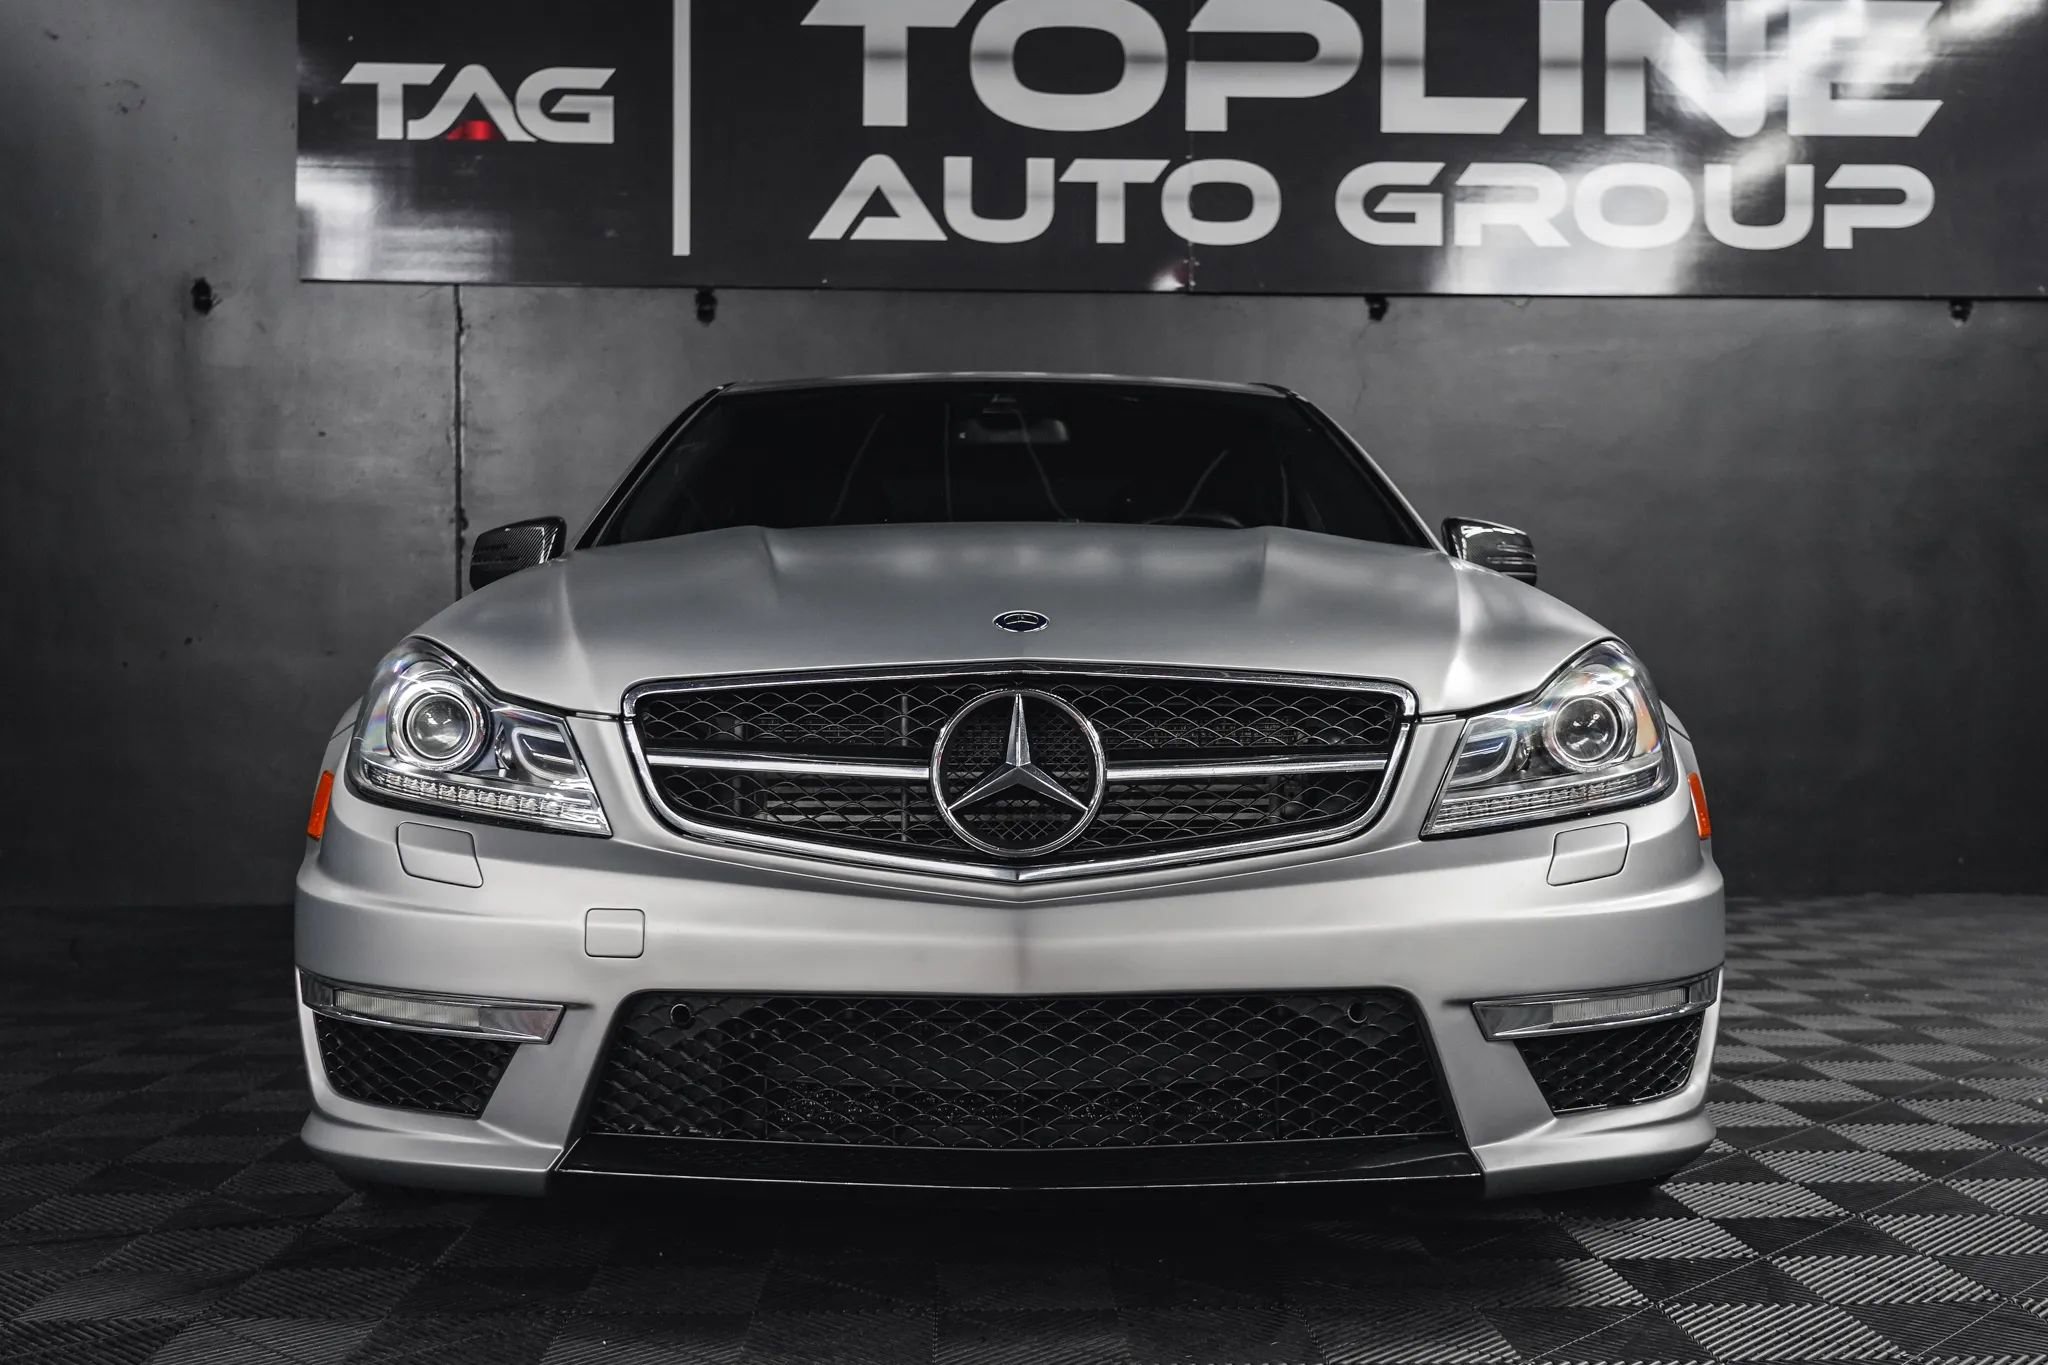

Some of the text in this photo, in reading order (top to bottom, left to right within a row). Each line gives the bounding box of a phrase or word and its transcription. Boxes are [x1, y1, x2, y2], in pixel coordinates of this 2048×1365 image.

[341, 62, 616, 144] TAG
[801, 0, 1943, 137] TOPLINE
[808, 153, 1936, 250] AUTO GROUP
